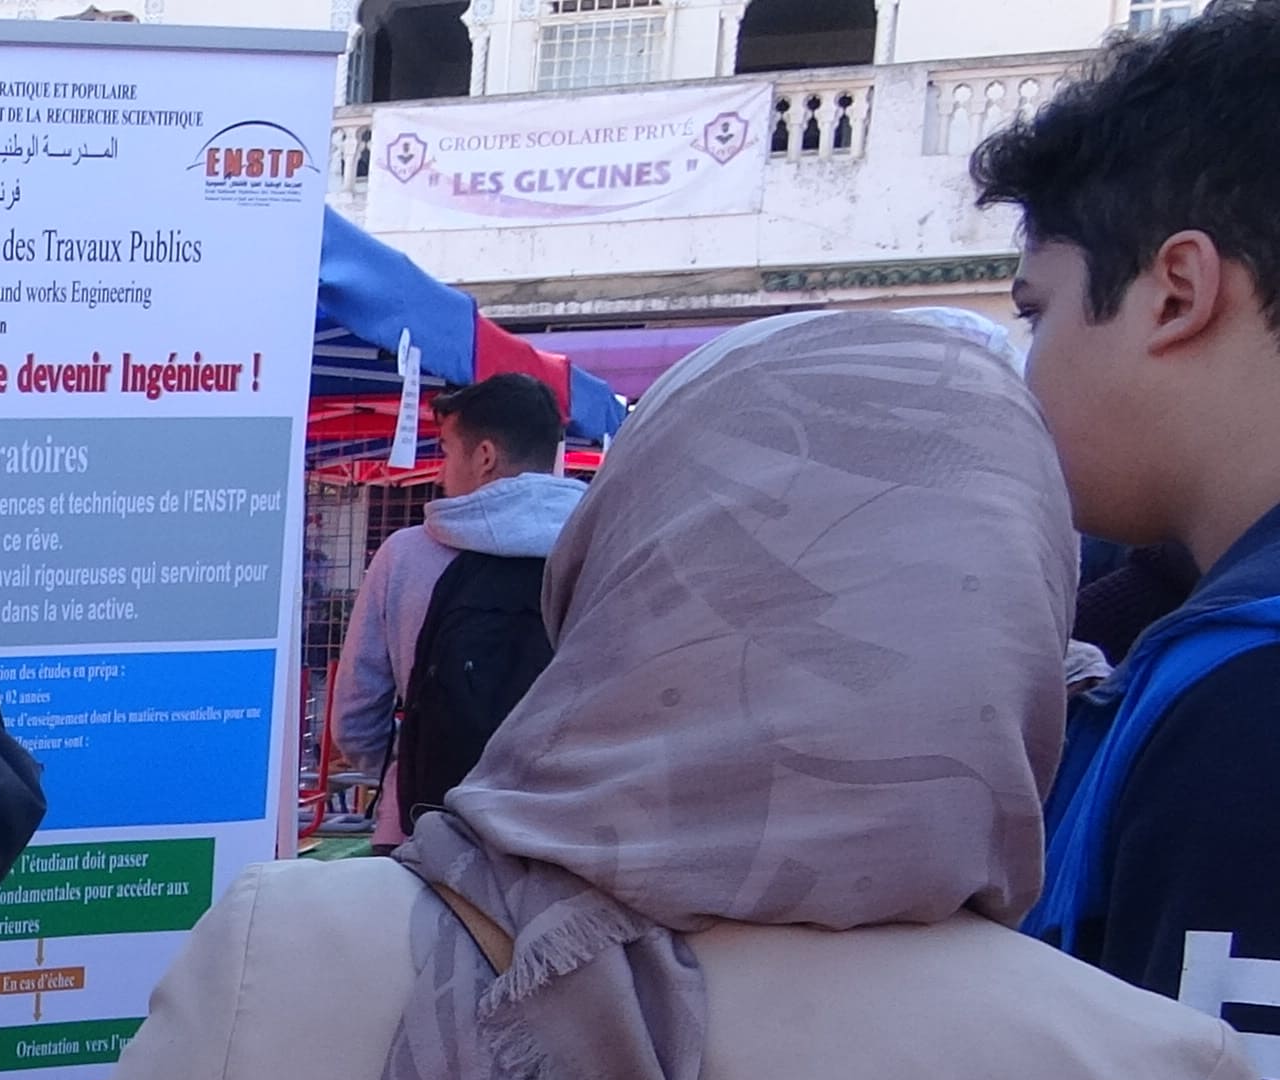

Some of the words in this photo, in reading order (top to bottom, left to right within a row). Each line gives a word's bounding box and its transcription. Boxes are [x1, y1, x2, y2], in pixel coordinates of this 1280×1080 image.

[53, 83, 69, 98] ET
[71, 84, 137, 100] POPULAIRE
[8, 108, 24, 123] DE
[26, 108, 41, 123] LA
[47, 109, 118, 125] RECHERCHE
[121, 110, 203, 130] SCIENTIFIQUE
[439, 133, 521, 152] GROUPE
[525, 126, 627, 149] SCOLAIRE
[634, 118, 695, 141] PRIVÉ
[206, 148, 304, 178] ENSTP
[452, 171, 504, 197] LES
[514, 161, 671, 193] GLYCINES
[2, 229, 36, 262] des
[42, 230, 121, 263] Travaux
[129, 230, 202, 263] Publics
[26, 280, 67, 304] works
[71, 281, 152, 309] Engineering
[17, 351, 112, 394] devenir
[121, 351, 243, 400] Ingénieur
[49, 493, 66, 514] et
[68, 490, 154, 519] techniques
[159, 490, 178, 512] de
[183, 488, 246, 513] l'ENSTP
[250, 490, 281, 517] peut
[20, 852, 80, 874] l'étudiant
[82, 851, 107, 871] doit
[108, 852, 149, 872] passer
[2, 977, 18, 993] En
[19, 978, 36, 992] cas
